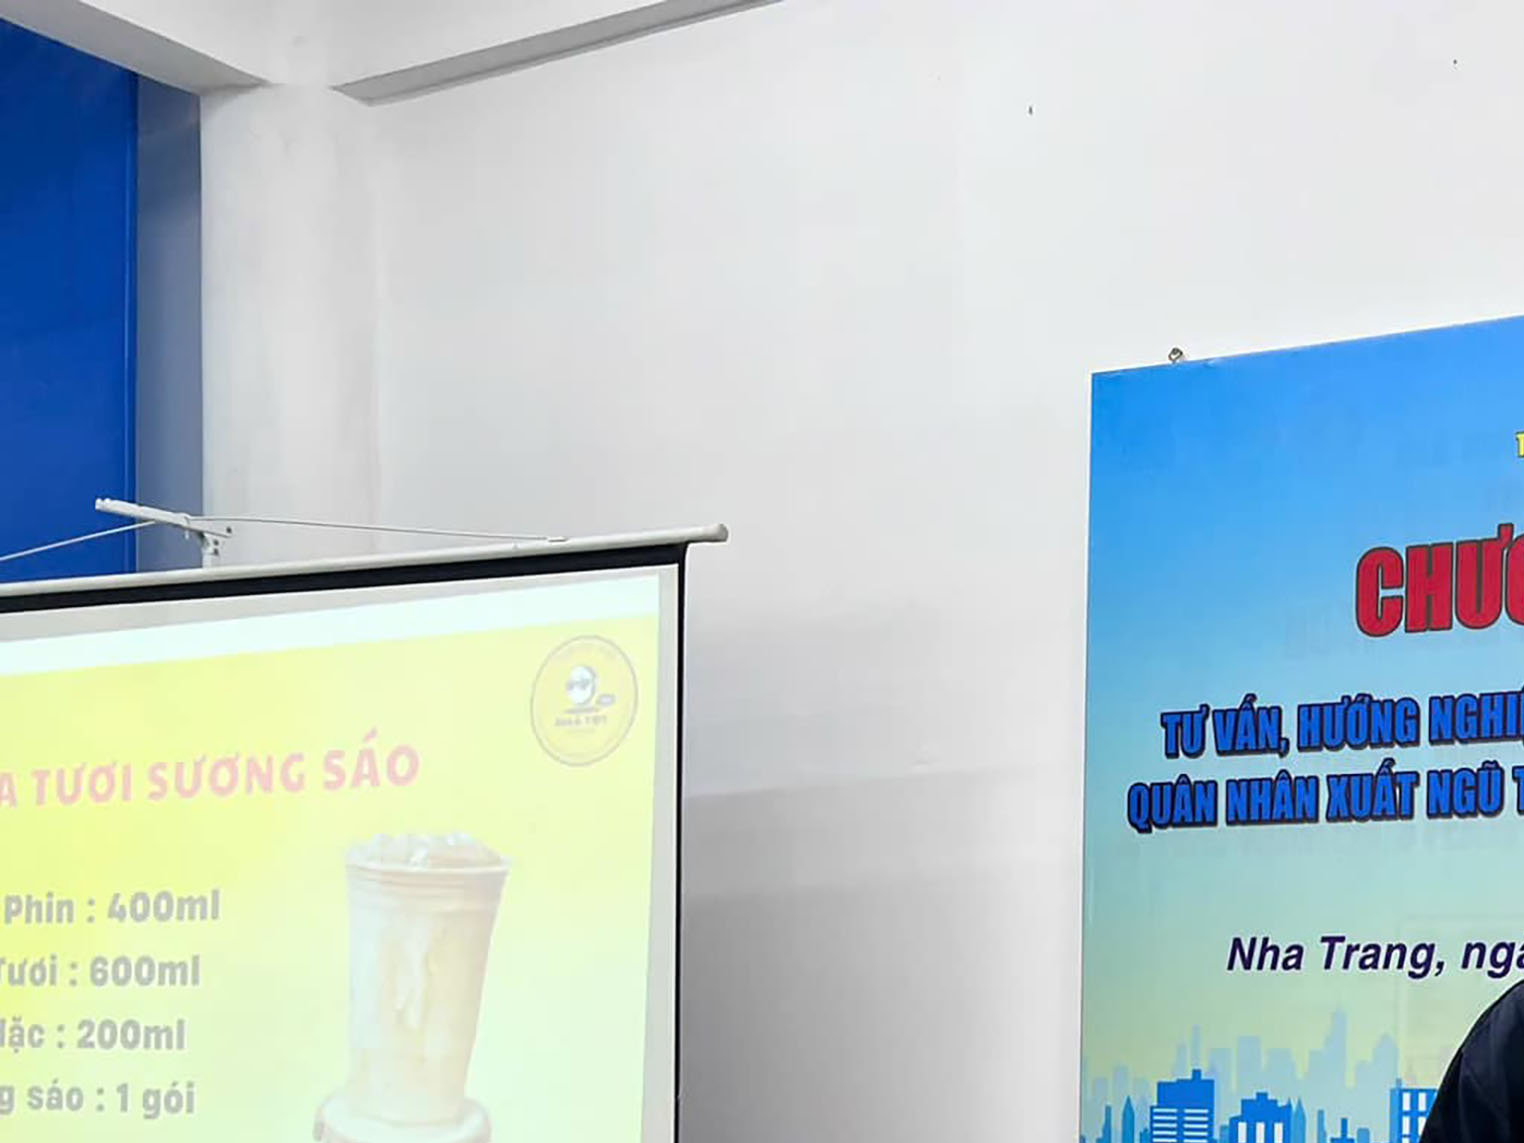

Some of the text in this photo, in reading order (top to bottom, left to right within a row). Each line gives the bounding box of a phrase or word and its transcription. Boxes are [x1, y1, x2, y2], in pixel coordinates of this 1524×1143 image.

[1160, 704, 1210, 759] TƯ
[1213, 693, 1290, 758] VẤN,
[1297, 693, 1420, 752] HƯỚNG
[31, 761, 133, 806] TƯƠI
[147, 752, 306, 801] SƯƠNG
[321, 727, 421, 791] SÁO
[1127, 774, 1218, 834] QUÂN
[1225, 768, 1320, 827] NHÂN
[1326, 757, 1419, 823] XUẤT
[1426, 760, 1505, 819] NGŨ
[3, 891, 75, 925] Phin
[106, 888, 220, 923] 400ml
[89, 954, 201, 987] 600ml
[1227, 936, 1304, 971] Nha
[1320, 935, 1445, 980] Trang,
[76, 1018, 186, 1051] 200ml
[27, 1078, 84, 1111] sáo
[116, 1083, 130, 1113] 1
[142, 1081, 196, 1119] gói
